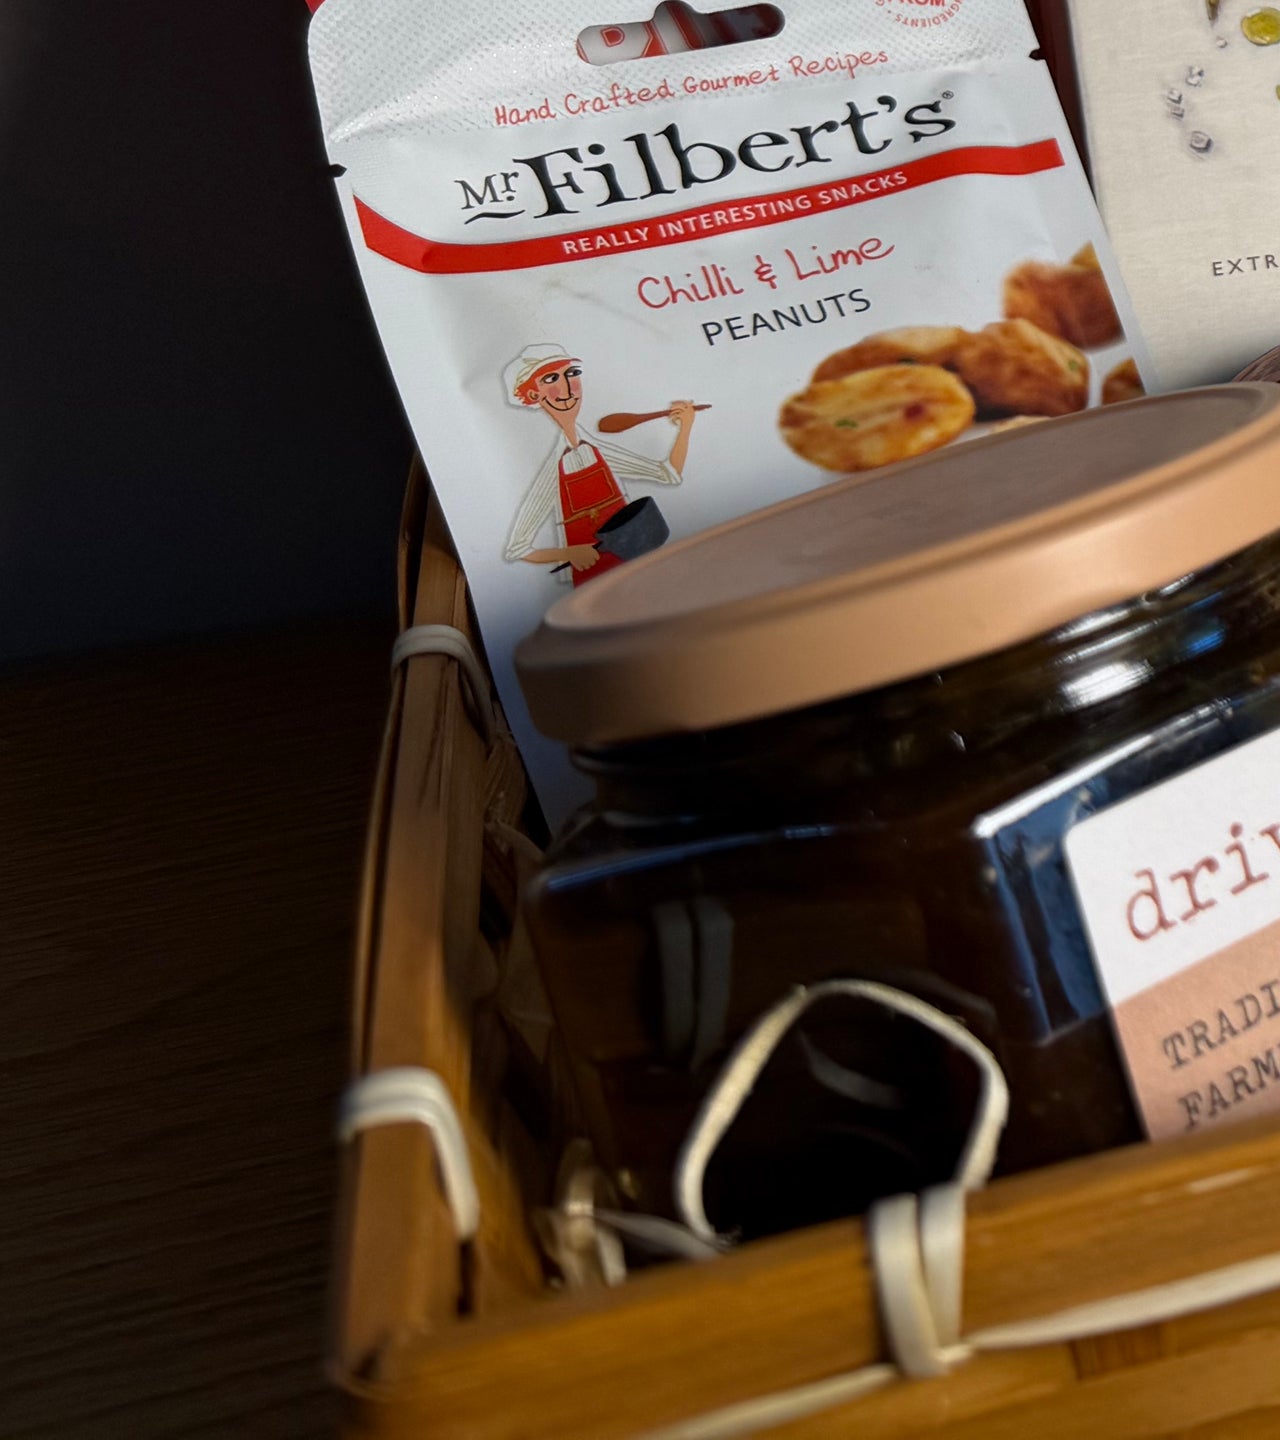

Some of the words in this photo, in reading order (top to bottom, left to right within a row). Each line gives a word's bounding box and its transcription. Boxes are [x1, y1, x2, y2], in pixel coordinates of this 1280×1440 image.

[494, 101, 557, 126] Hand
[564, 78, 675, 117] Crafted
[683, 65, 780, 96] Gourmet
[788, 47, 889, 82] Recipes
[512, 94, 956, 219] Filbert's
[562, 225, 650, 256] REALLY
[659, 194, 813, 239] INTERESTING
[814, 171, 908, 206] SNACKS
[637, 264, 744, 310] Chilli
[753, 254, 778, 290] &
[785, 237, 895, 281] Lime
[702, 288, 872, 346] PEANUTS
